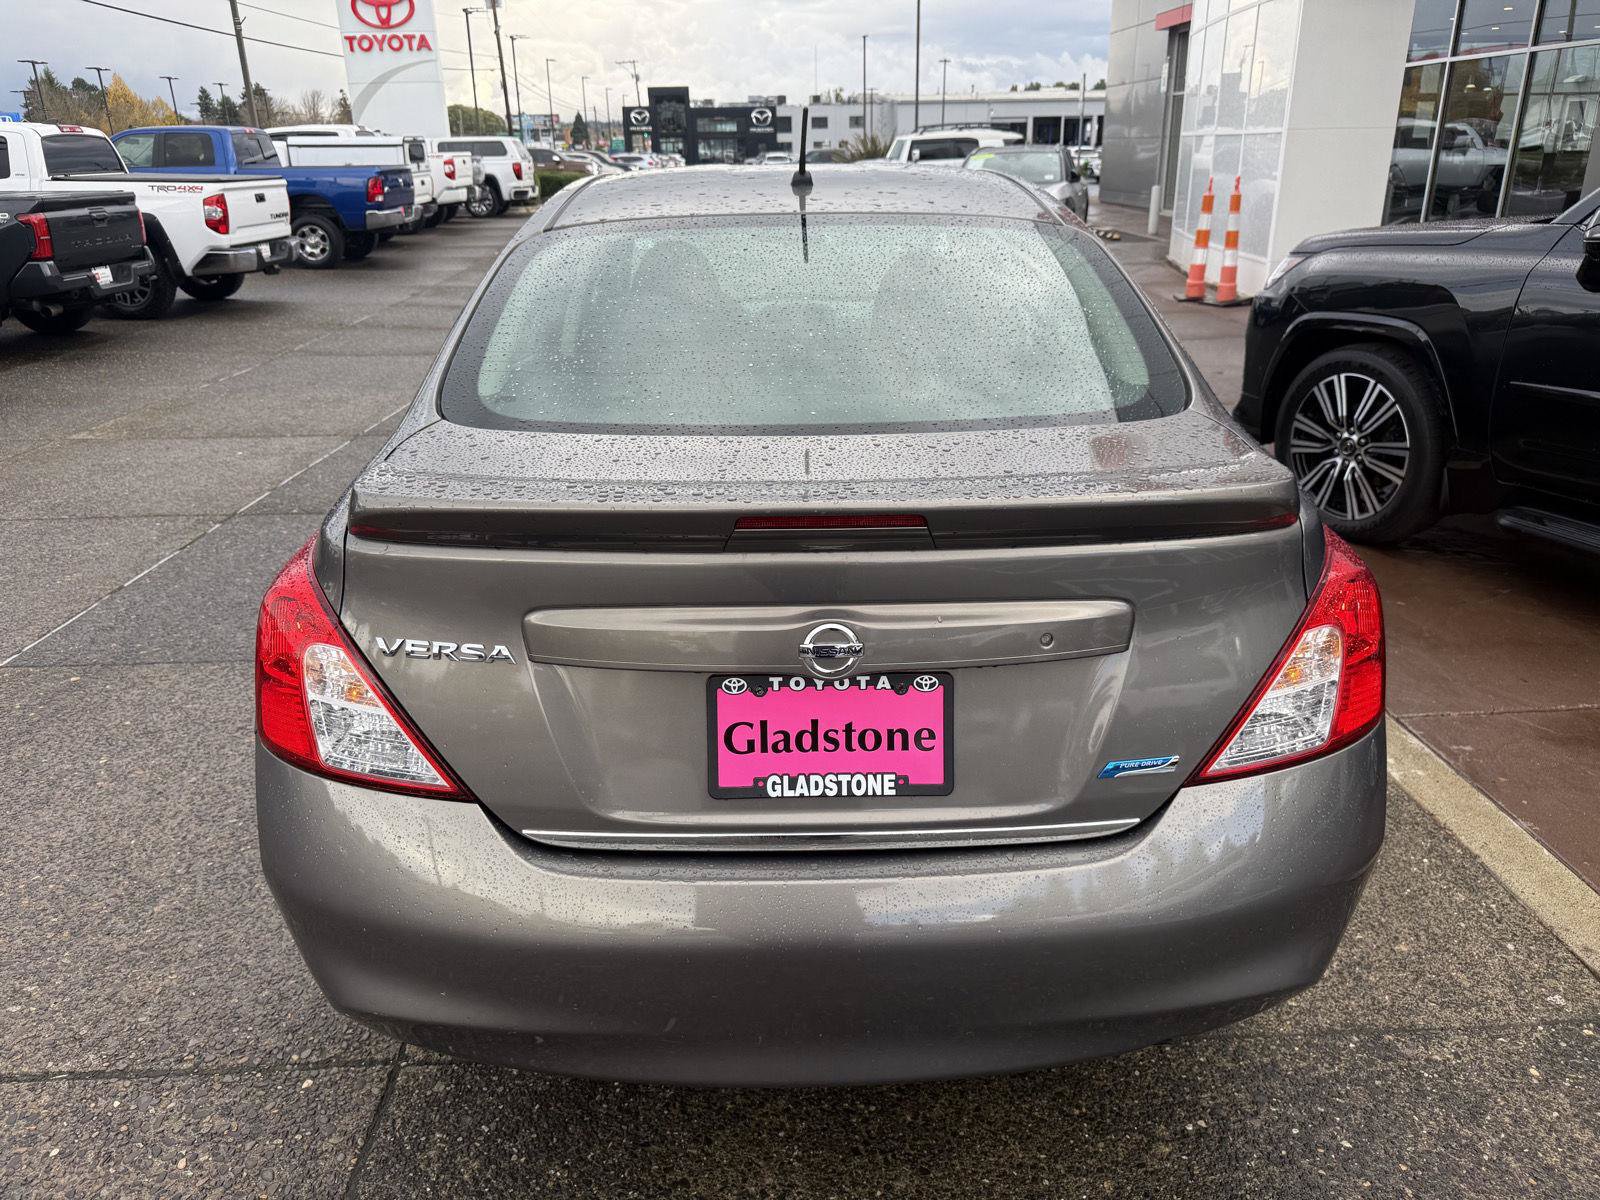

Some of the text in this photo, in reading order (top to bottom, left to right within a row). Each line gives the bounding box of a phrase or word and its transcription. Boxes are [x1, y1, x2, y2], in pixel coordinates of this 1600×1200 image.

[344, 34, 432, 52] TOYOTA
[375, 636, 517, 665] VERSA
[806, 644, 861, 658] NISSAN
[769, 676, 892, 691] TOYOTA
[723, 718, 937, 755] Gladstone
[766, 773, 897, 798] GLADSTONE
